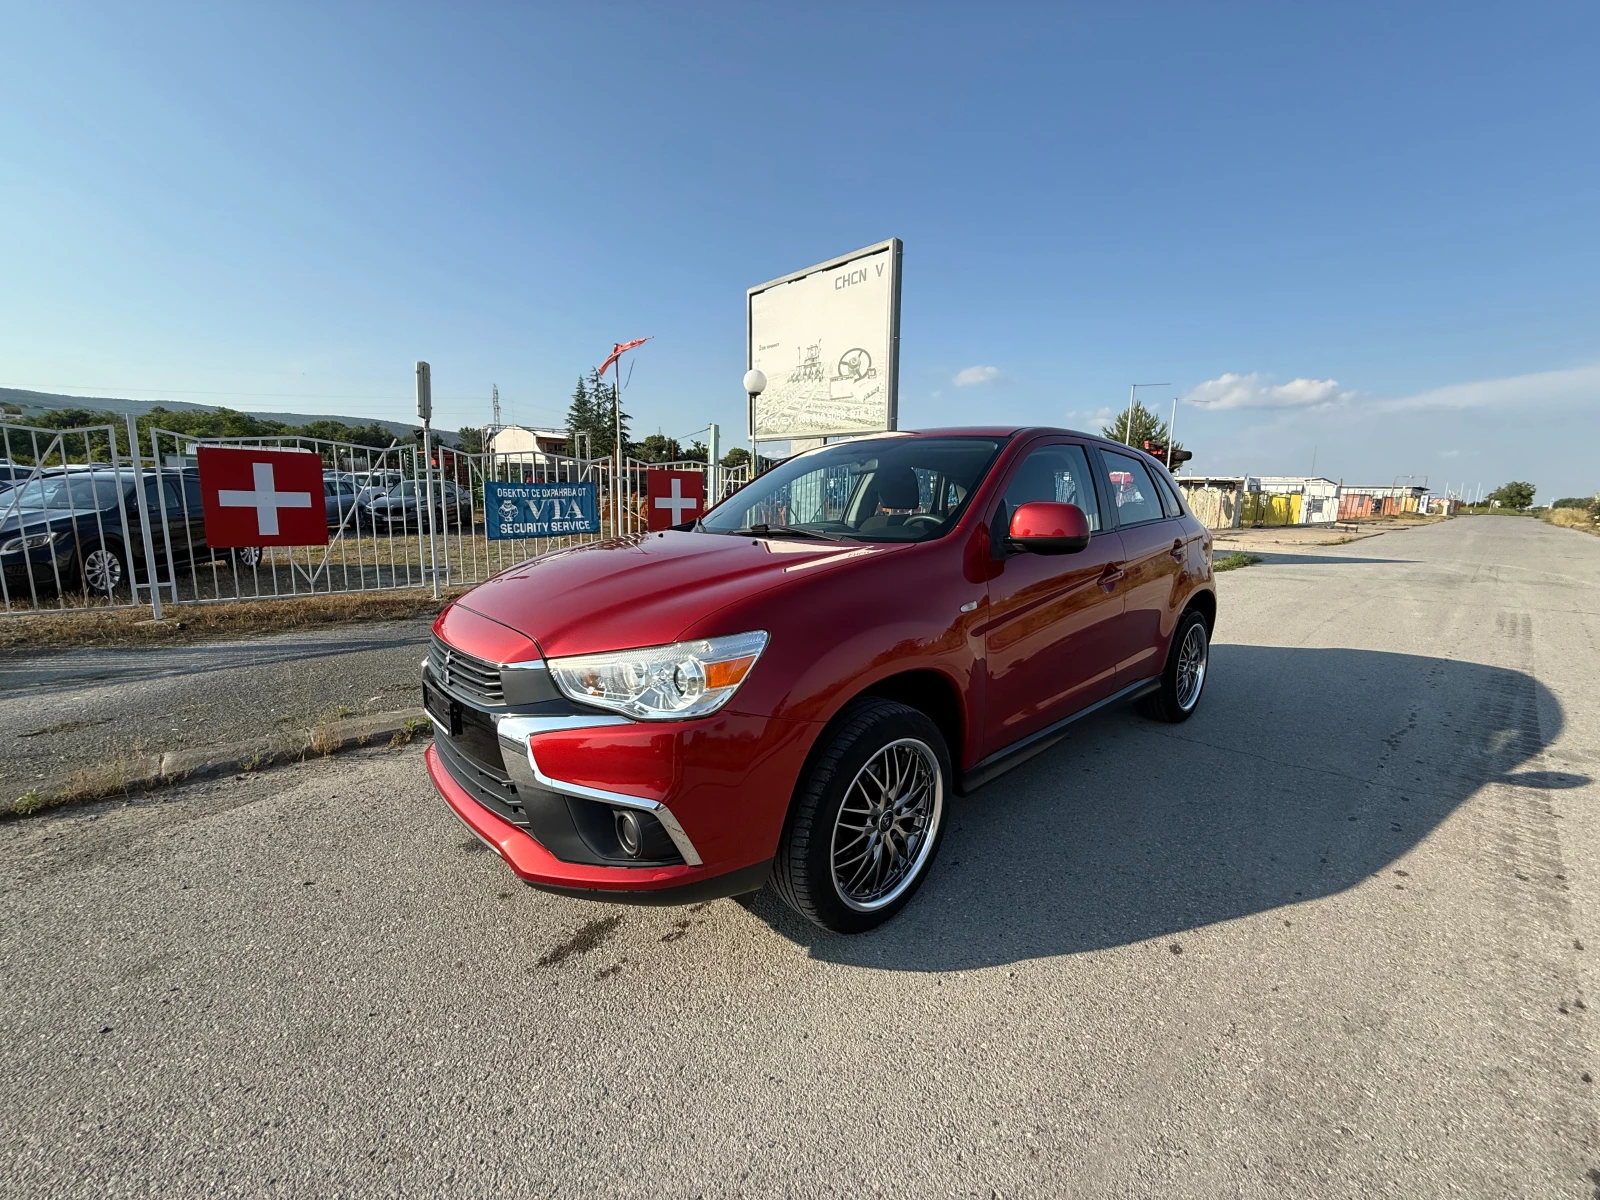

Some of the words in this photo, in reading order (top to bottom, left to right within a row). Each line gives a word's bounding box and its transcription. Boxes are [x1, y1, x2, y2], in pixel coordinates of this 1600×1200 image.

[497, 488, 529, 498] ОБЕКТЪТ
[531, 488, 541, 497] СЕ
[541, 487, 577, 497] ОХРАНЯВА
[577, 487, 586, 497] ОТ
[525, 499, 585, 520] VTA
[500, 522, 549, 534] SECURITY
[551, 520, 591, 532] SERVICE
